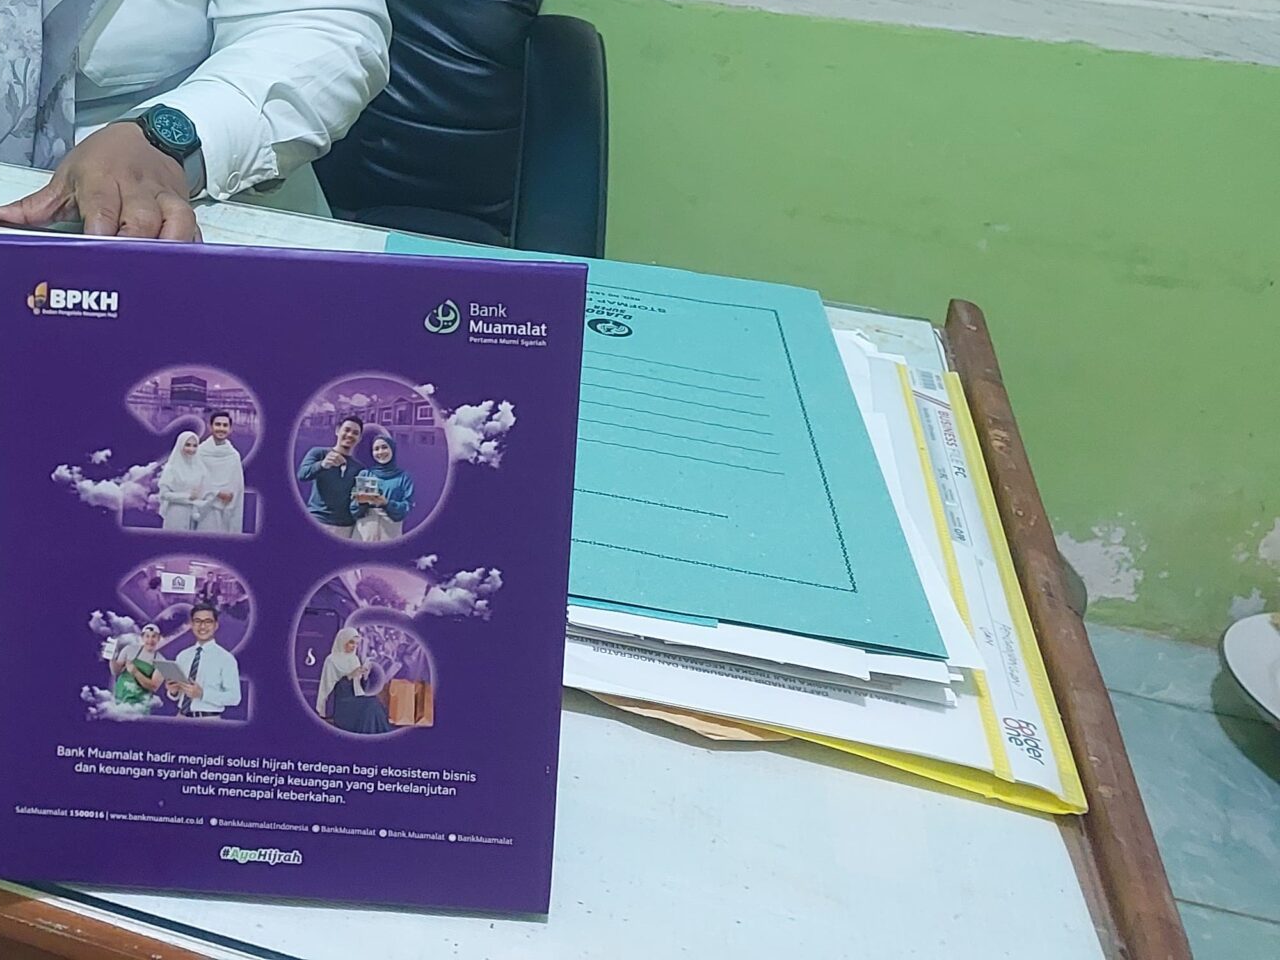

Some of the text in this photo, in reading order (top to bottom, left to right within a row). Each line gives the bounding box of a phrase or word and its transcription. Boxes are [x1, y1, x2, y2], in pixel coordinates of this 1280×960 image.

[49, 288, 119, 311] BPKH
[469, 302, 507, 318] Bank
[469, 319, 547, 337] Muamalat
[469, 336, 498, 345] Pertama
[520, 339, 547, 348] Syariah
[593, 646, 656, 664] MODERATOR
[658, 659, 679, 668] DAN
[1003, 716, 1024, 746] One
[1018, 719, 1045, 766] Folder
[57, 745, 477, 782] Bank Muamalat hadir menjadi solusi hijrah terdepan bagi ekosistem bisnis
[74, 762, 457, 797] dan keuangan syariah dengan kinerja keuangan yang berkelanjutan
[182, 784, 346, 805] untuk mencapai keberkahan.
[15, 806, 68, 817] SalaMuamalat
[69, 809, 105, 820] 1500016
[110, 812, 204, 826] www.bankmuamalat.co.id
[218, 819, 309, 832] BankMuamalatIndonesia
[320, 825, 376, 836] BankMuamalat
[457, 834, 514, 846] BankMuamalat
[220, 846, 302, 865] #AyoHijrah
